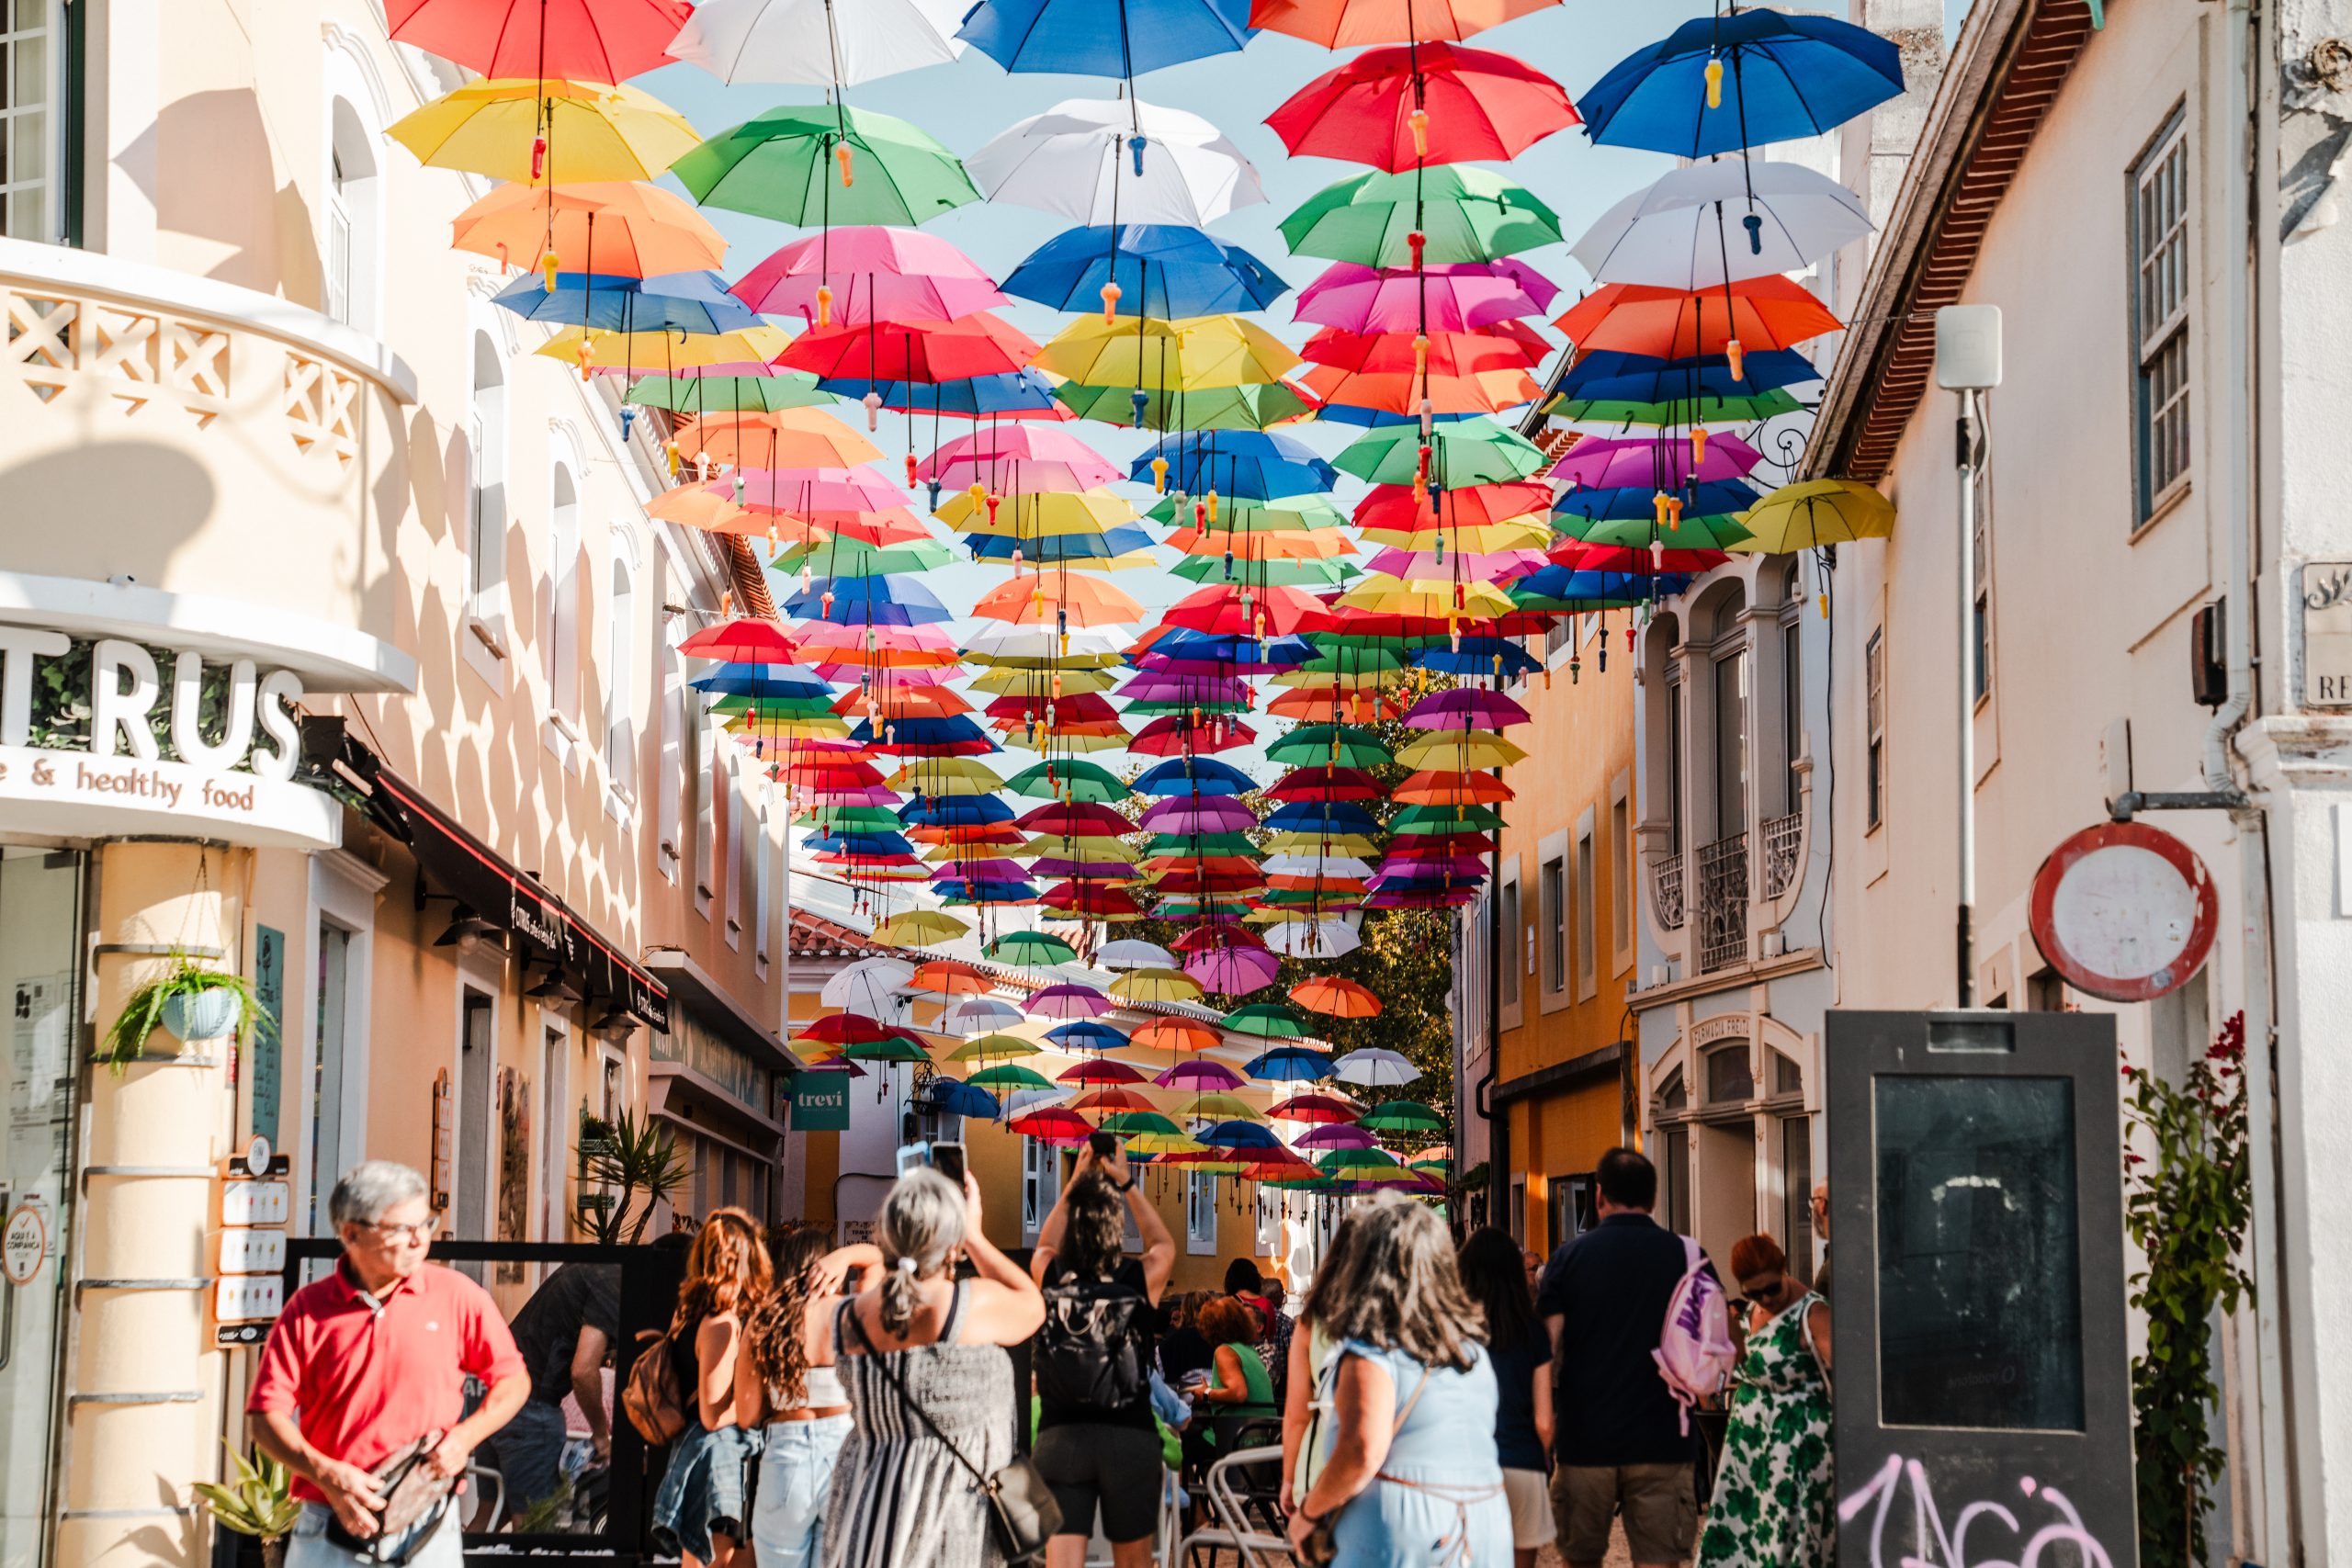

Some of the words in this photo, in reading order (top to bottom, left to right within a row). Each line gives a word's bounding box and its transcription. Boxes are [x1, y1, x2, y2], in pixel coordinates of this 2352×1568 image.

[31, 758, 55, 786] &
[77, 761, 182, 808] healthy
[202, 778, 254, 811] food
[798, 1090, 842, 1107] trevi
